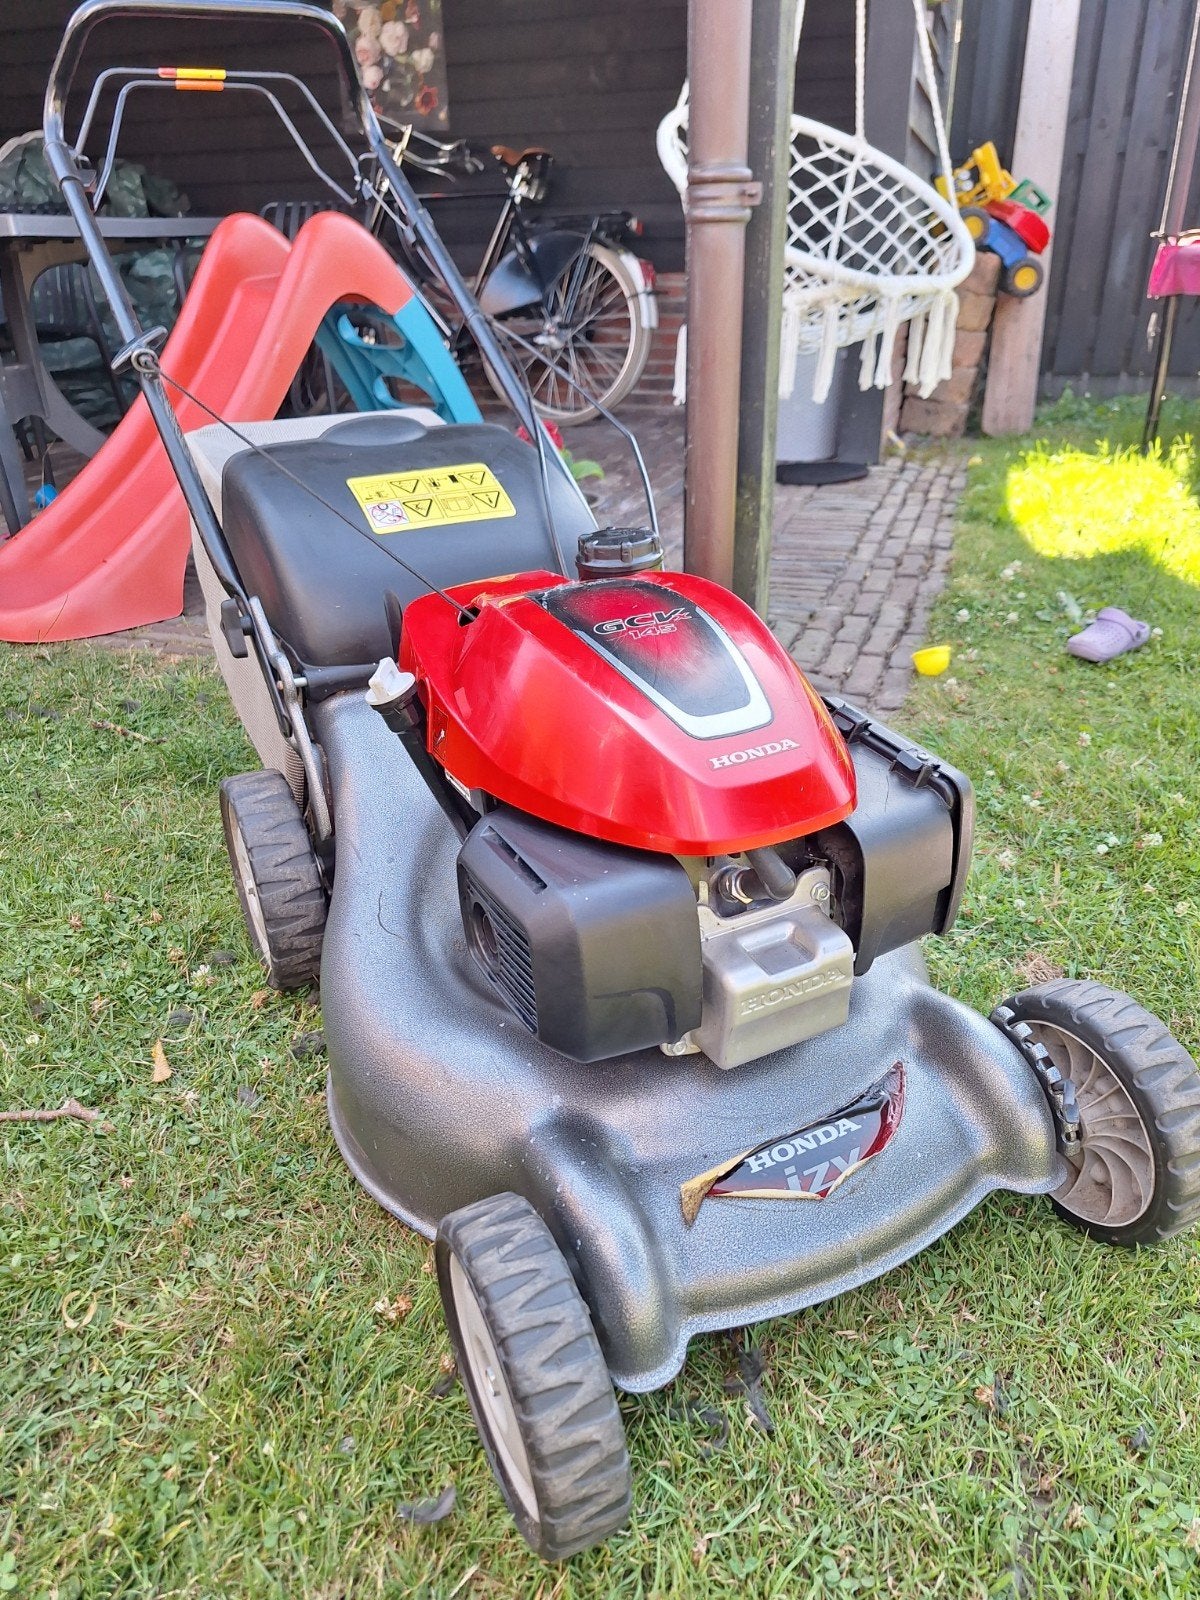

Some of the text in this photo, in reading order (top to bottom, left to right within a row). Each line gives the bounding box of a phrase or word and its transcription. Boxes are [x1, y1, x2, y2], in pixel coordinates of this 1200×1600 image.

[628, 623, 678, 640] 145
[708, 738, 801, 769] HONDA
[740, 967, 846, 1016] HONDA
[744, 1117, 863, 1174] HONDA
